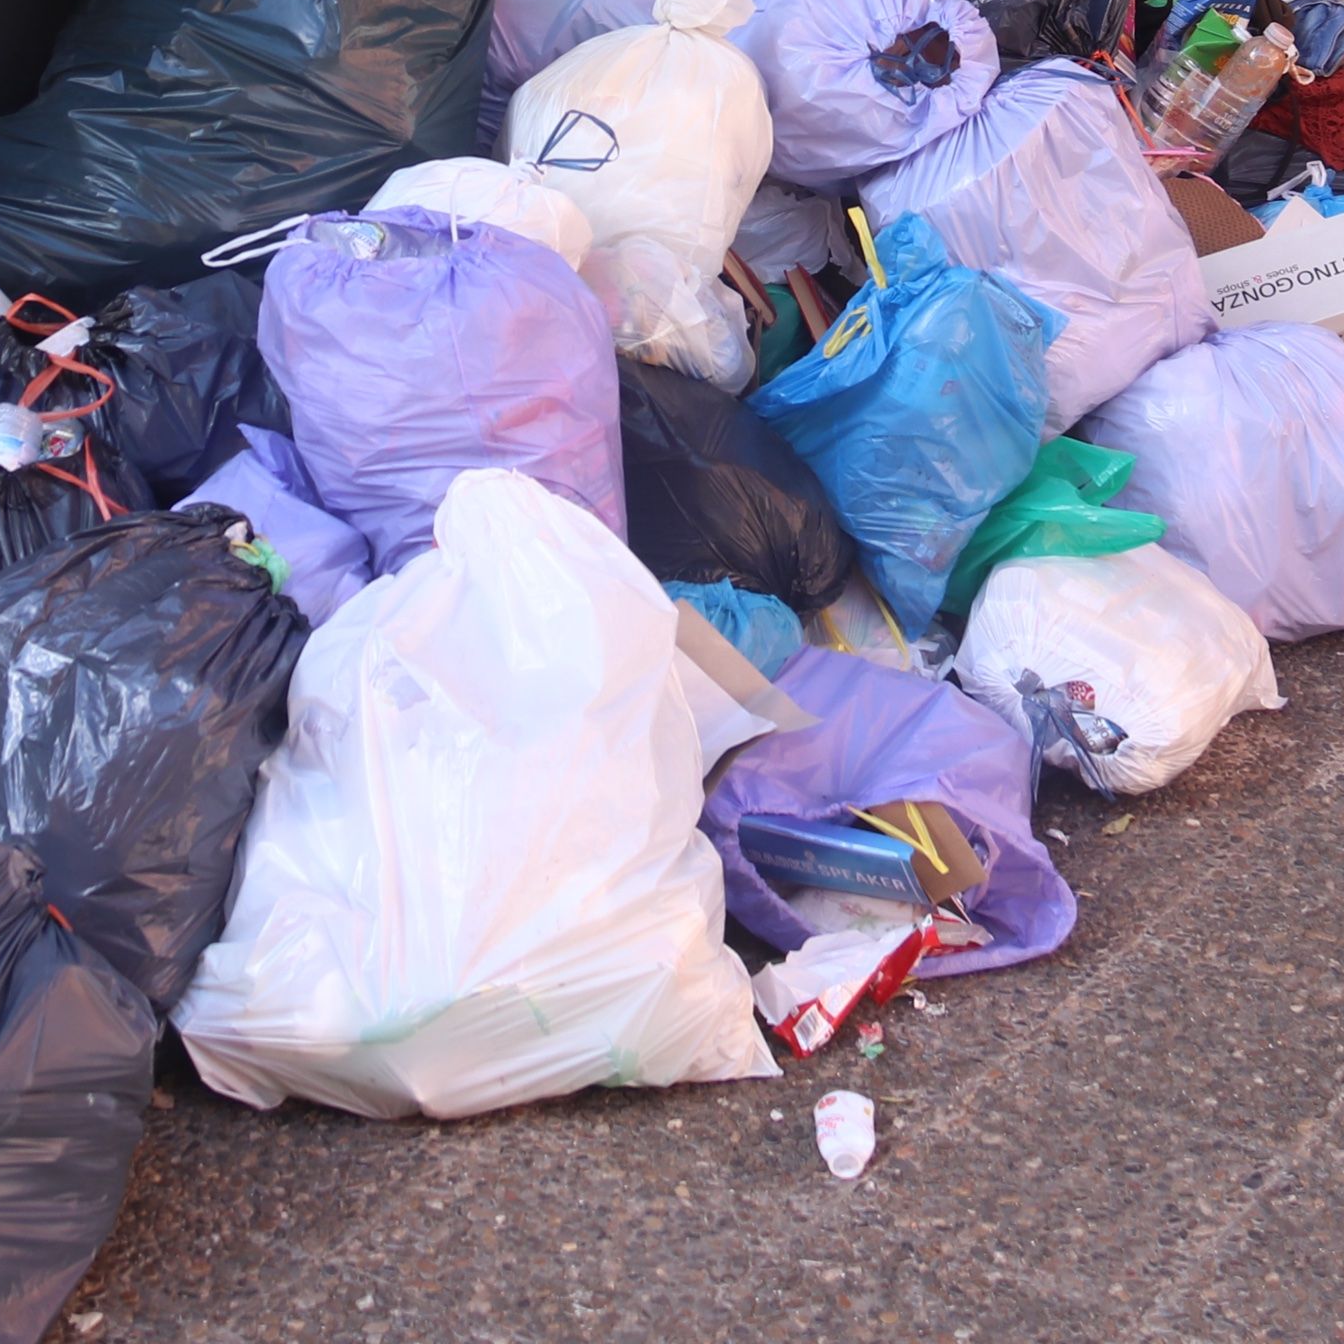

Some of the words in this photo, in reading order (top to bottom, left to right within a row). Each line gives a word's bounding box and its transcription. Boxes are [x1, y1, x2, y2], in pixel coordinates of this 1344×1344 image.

[1252, 274, 1264, 285] &
[1265, 263, 1300, 279] shoes
[1216, 279, 1250, 296] shops
[1210, 277, 1295, 318] GONZÁ
[817, 864, 907, 893] SPEAKER
